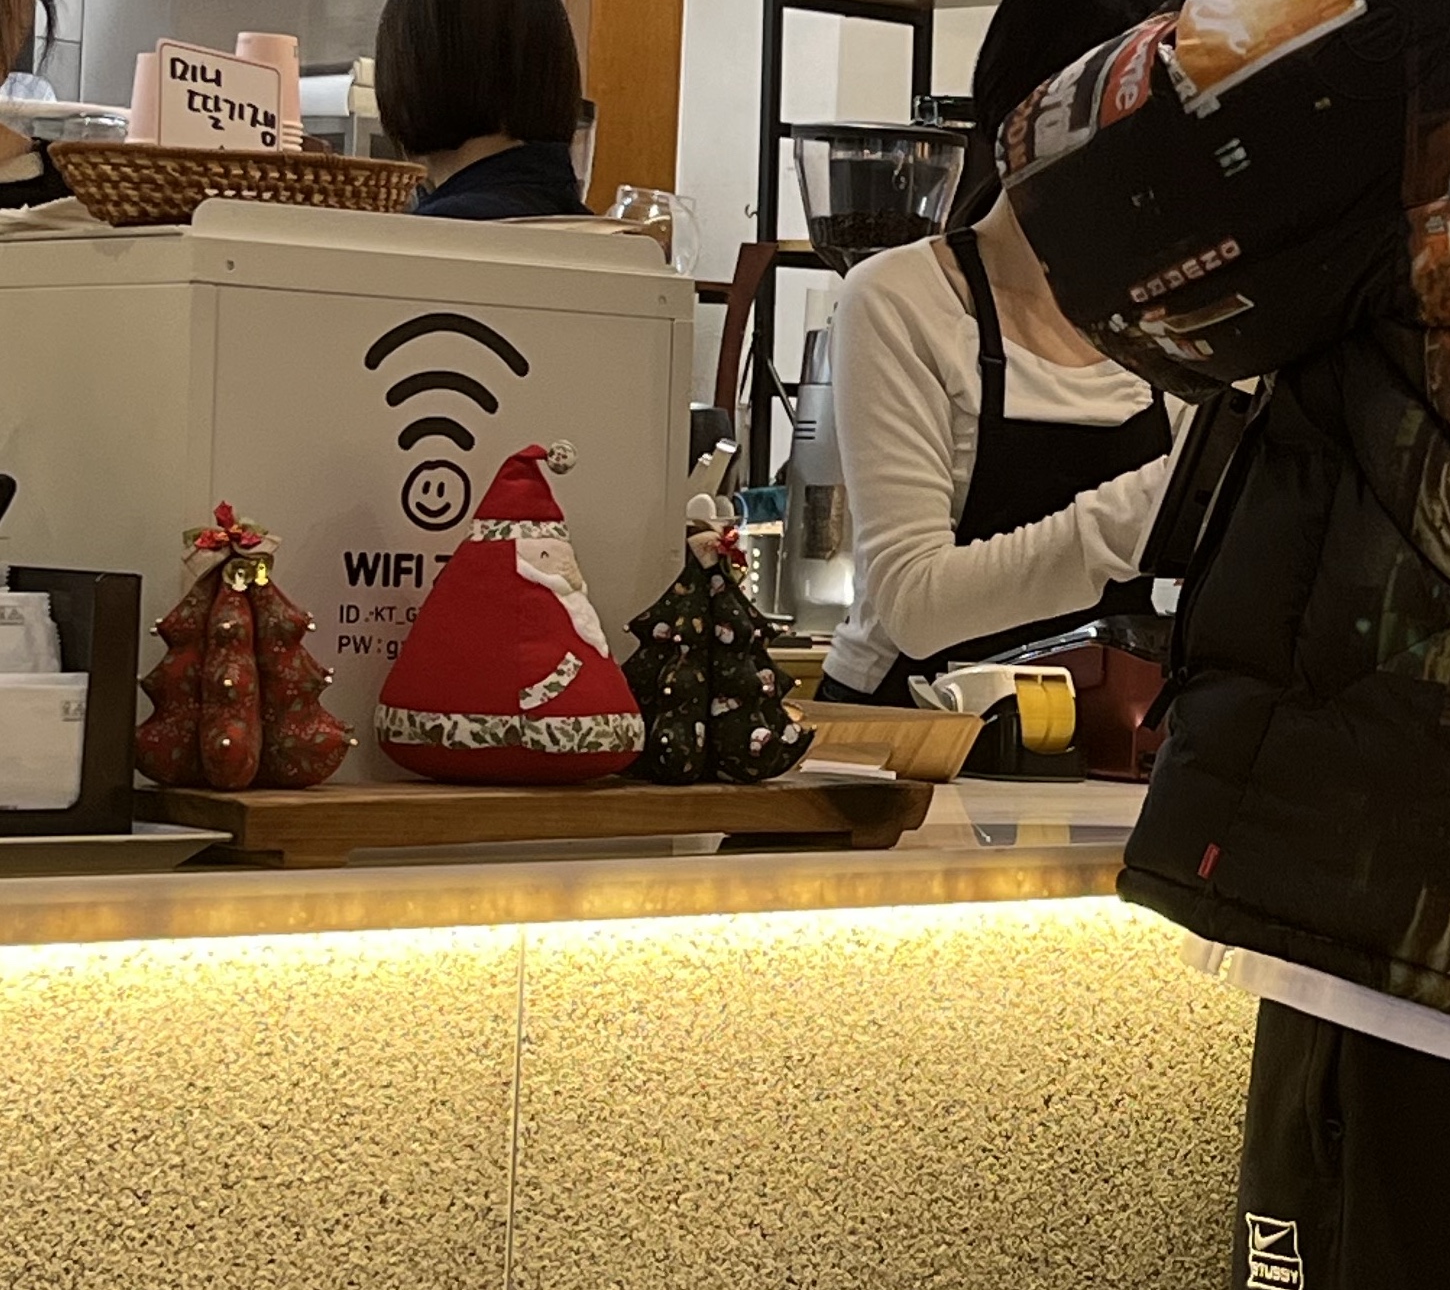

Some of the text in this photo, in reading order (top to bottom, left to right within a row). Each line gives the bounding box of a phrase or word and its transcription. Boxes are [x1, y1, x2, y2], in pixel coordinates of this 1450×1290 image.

[170, 57, 222, 87] 미니
[344, 552, 423, 588] WIFI
[375, 606, 417, 625] KT_G
